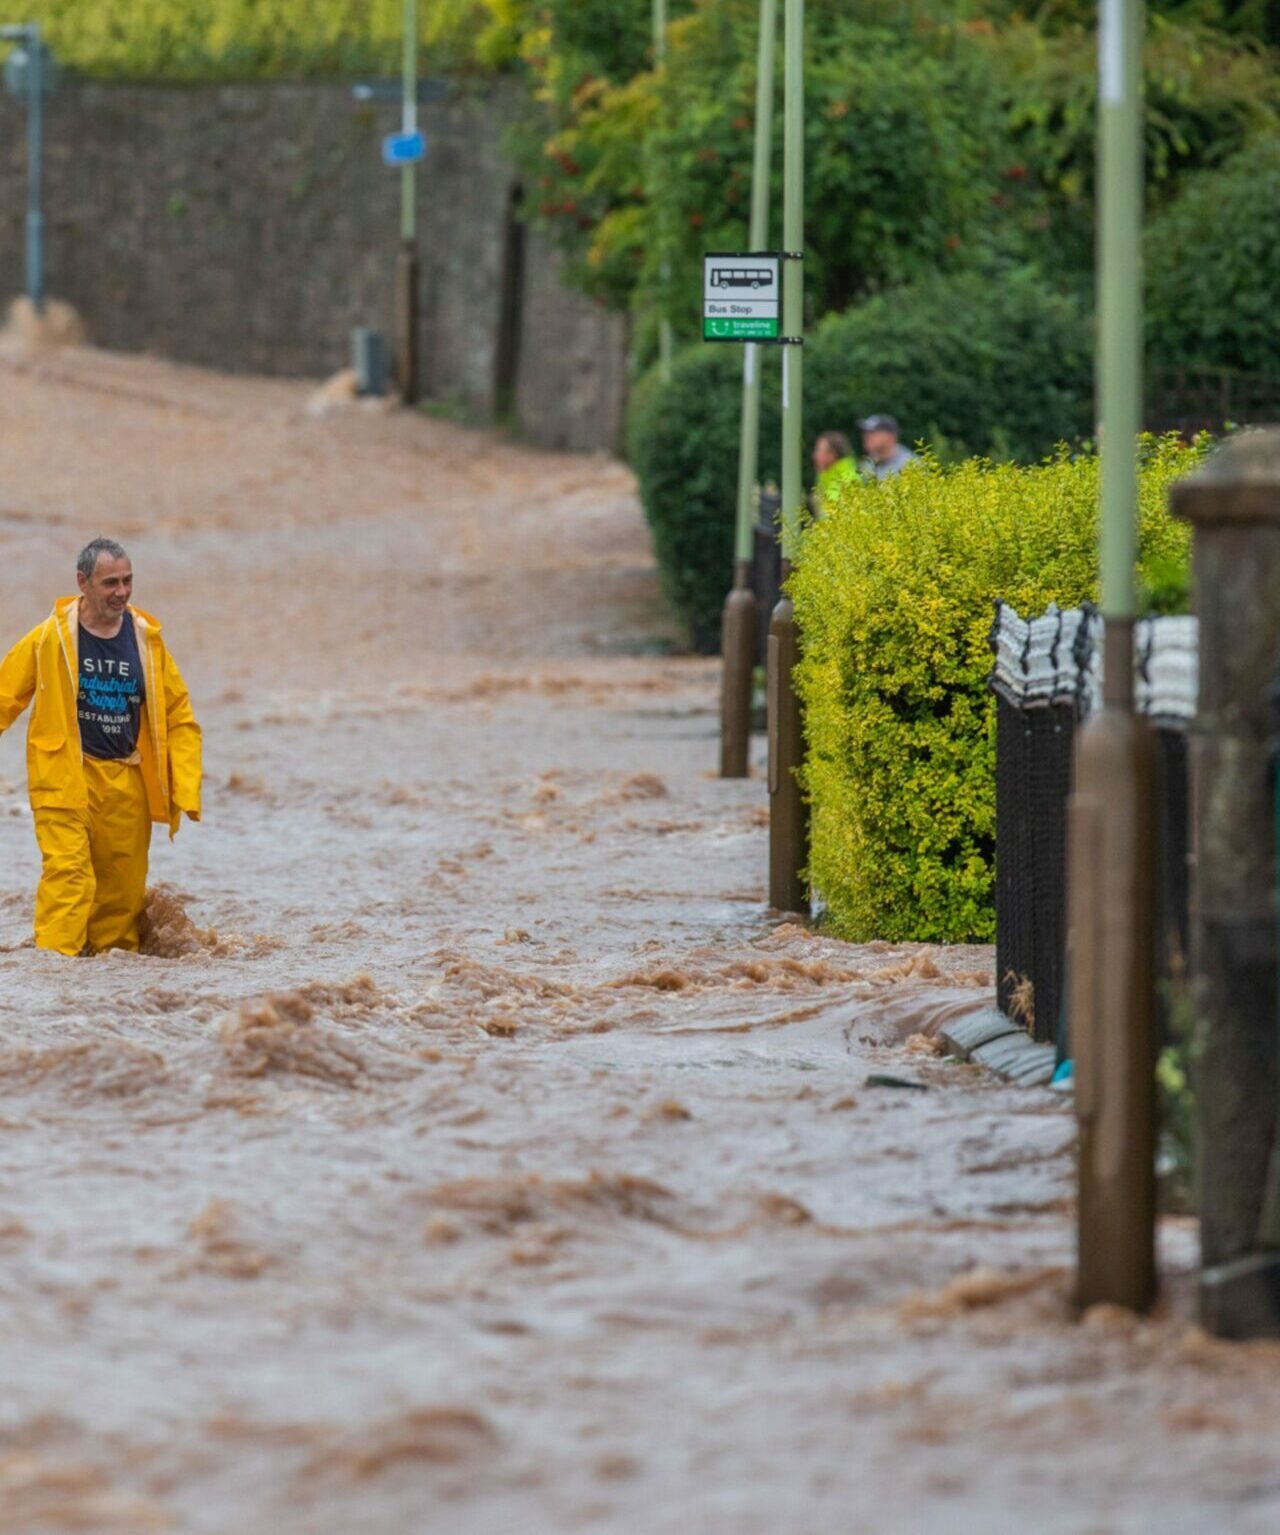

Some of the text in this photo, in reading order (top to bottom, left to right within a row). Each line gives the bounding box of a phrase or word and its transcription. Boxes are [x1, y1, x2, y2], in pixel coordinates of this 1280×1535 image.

[709, 305, 752, 315] Bus Stop
[83, 658, 130, 676] SITE
[87, 690, 127, 713] Supply
